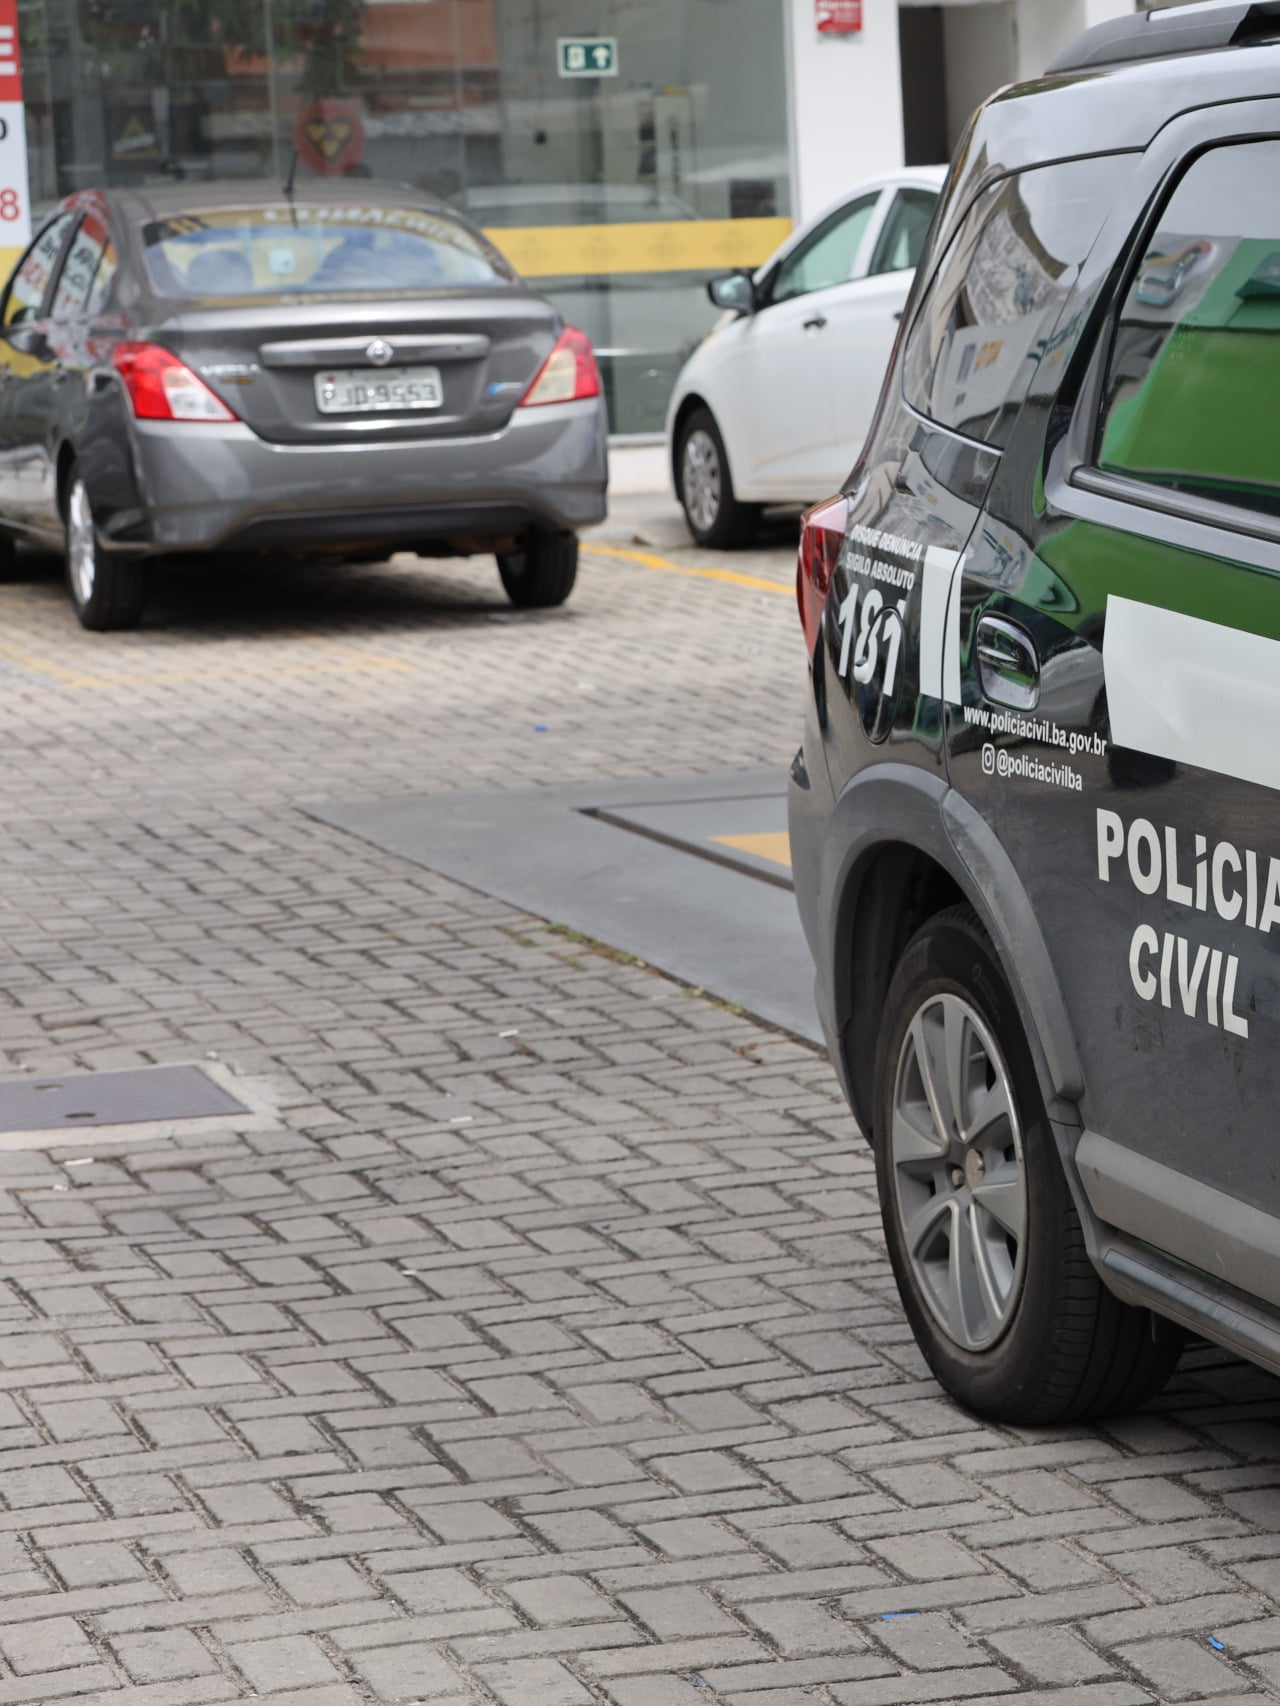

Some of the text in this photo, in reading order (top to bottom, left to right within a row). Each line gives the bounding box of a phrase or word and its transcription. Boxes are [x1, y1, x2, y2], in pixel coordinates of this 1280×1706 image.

[845, 552, 916, 591] SIGILO ABSOLUTO
[878, 532, 924, 563] DENÚNCIA
[838, 583, 906, 698] 181
[963, 705, 1108, 757] www.policiacivil.ba.gov.br
[996, 748, 1084, 792] @policiacivilba
[1128, 924, 1250, 1040] CIVIL
